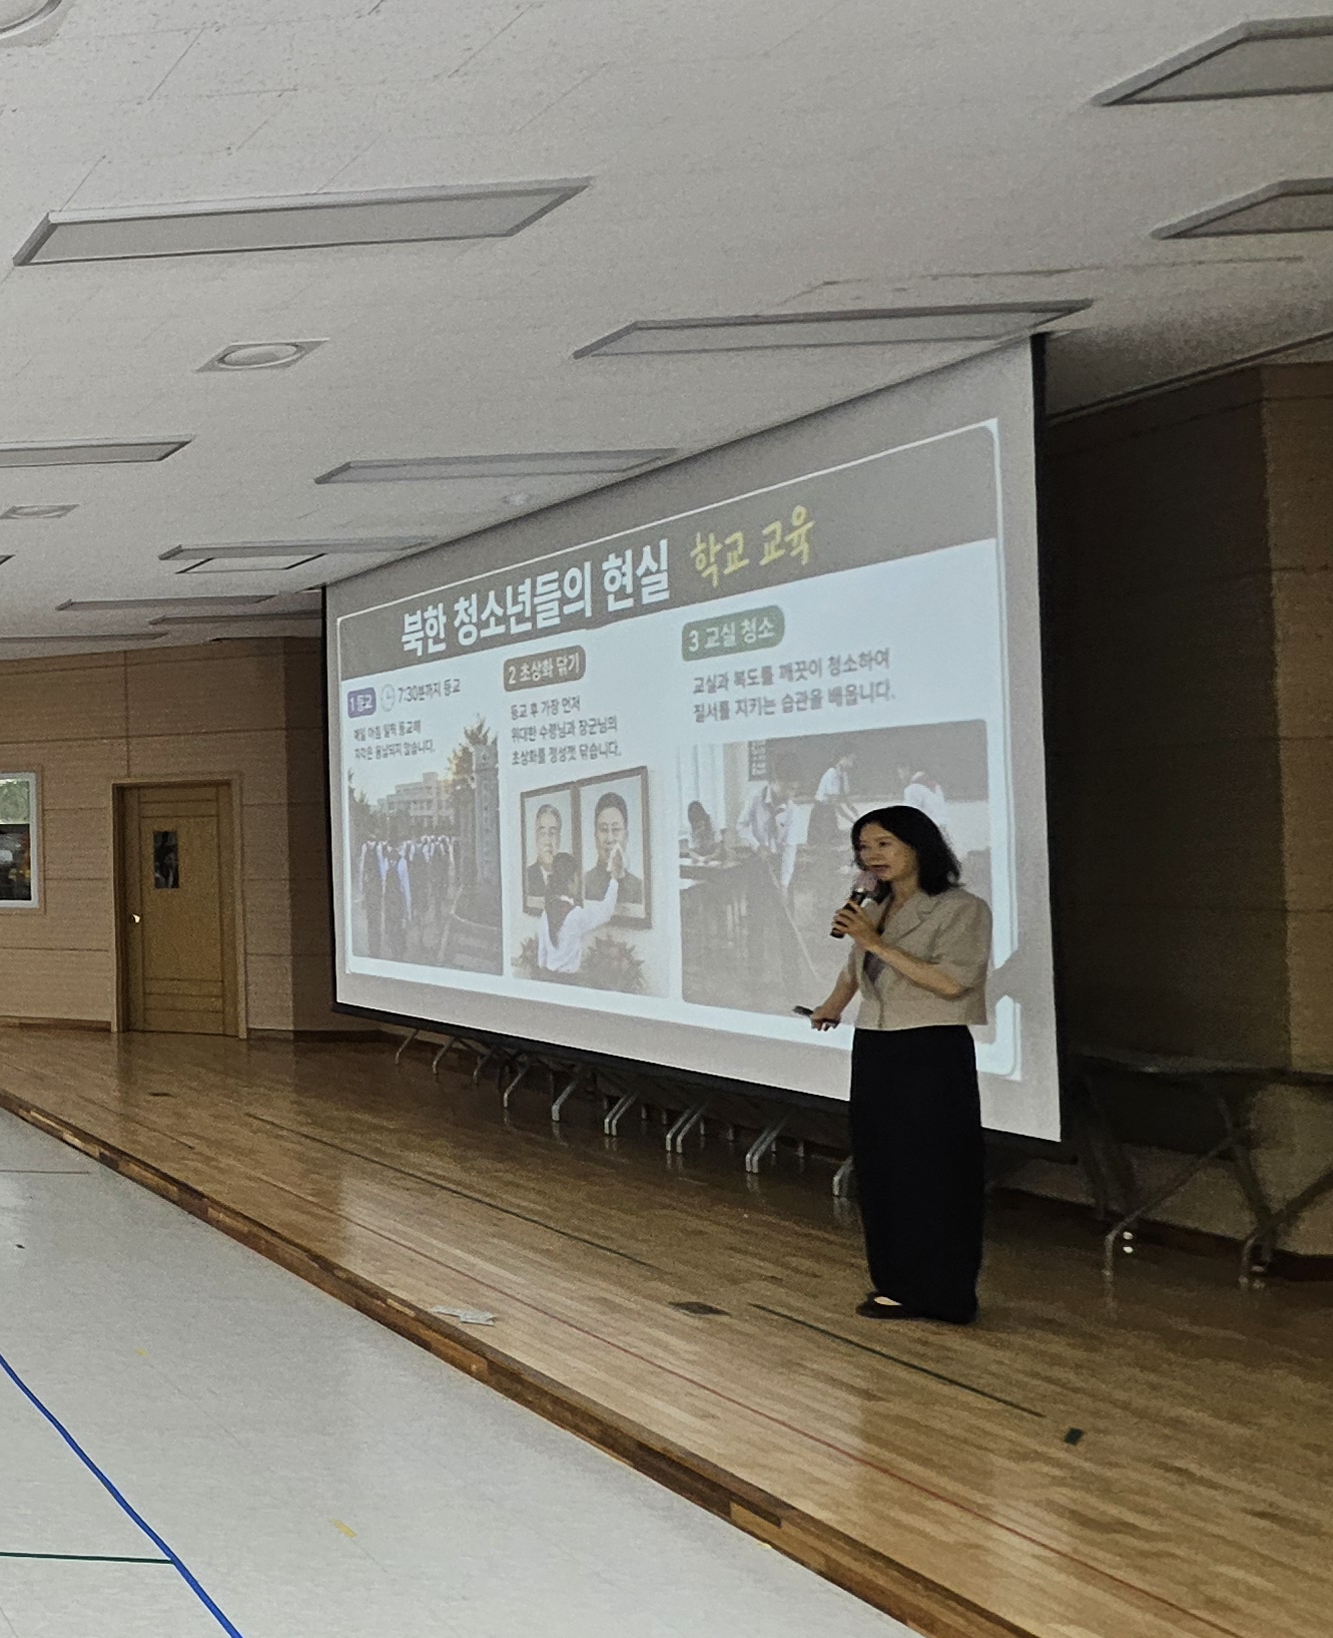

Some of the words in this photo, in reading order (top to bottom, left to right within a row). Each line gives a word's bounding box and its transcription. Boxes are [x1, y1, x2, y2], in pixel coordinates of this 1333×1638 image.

[401, 602, 447, 657] 북한
[453, 561, 592, 647] 청소년들의
[602, 539, 671, 613] 현실
[690, 531, 748, 588] 학교
[759, 504, 815, 566] 교육
[688, 630, 699, 652] 3
[704, 622, 736, 649] 교실
[740, 616, 775, 644] 청소
[508, 665, 517, 684] 2
[519, 658, 553, 682] 초상화
[555, 652, 580, 677] 닦기
[693, 671, 730, 694] 교실과
[734, 665, 774, 689] 복도를
[778, 658, 823, 682] 깨끗이
[827, 647, 890, 677] 청소하여
[443, 678, 461, 697] 등교
[349, 697, 356, 712] 1
[510, 704, 528, 720] 등교
[541, 699, 559, 716] 가장
[561, 695, 580, 713] 먼저
[693, 699, 730, 723] 질서를
[735, 696, 776, 718] 지키는
[782, 688, 824, 714] 습관을
[539, 721, 576, 740] 수령님과
[579, 715, 617, 736] 장군님의
[511, 747, 546, 766] 초상화를
